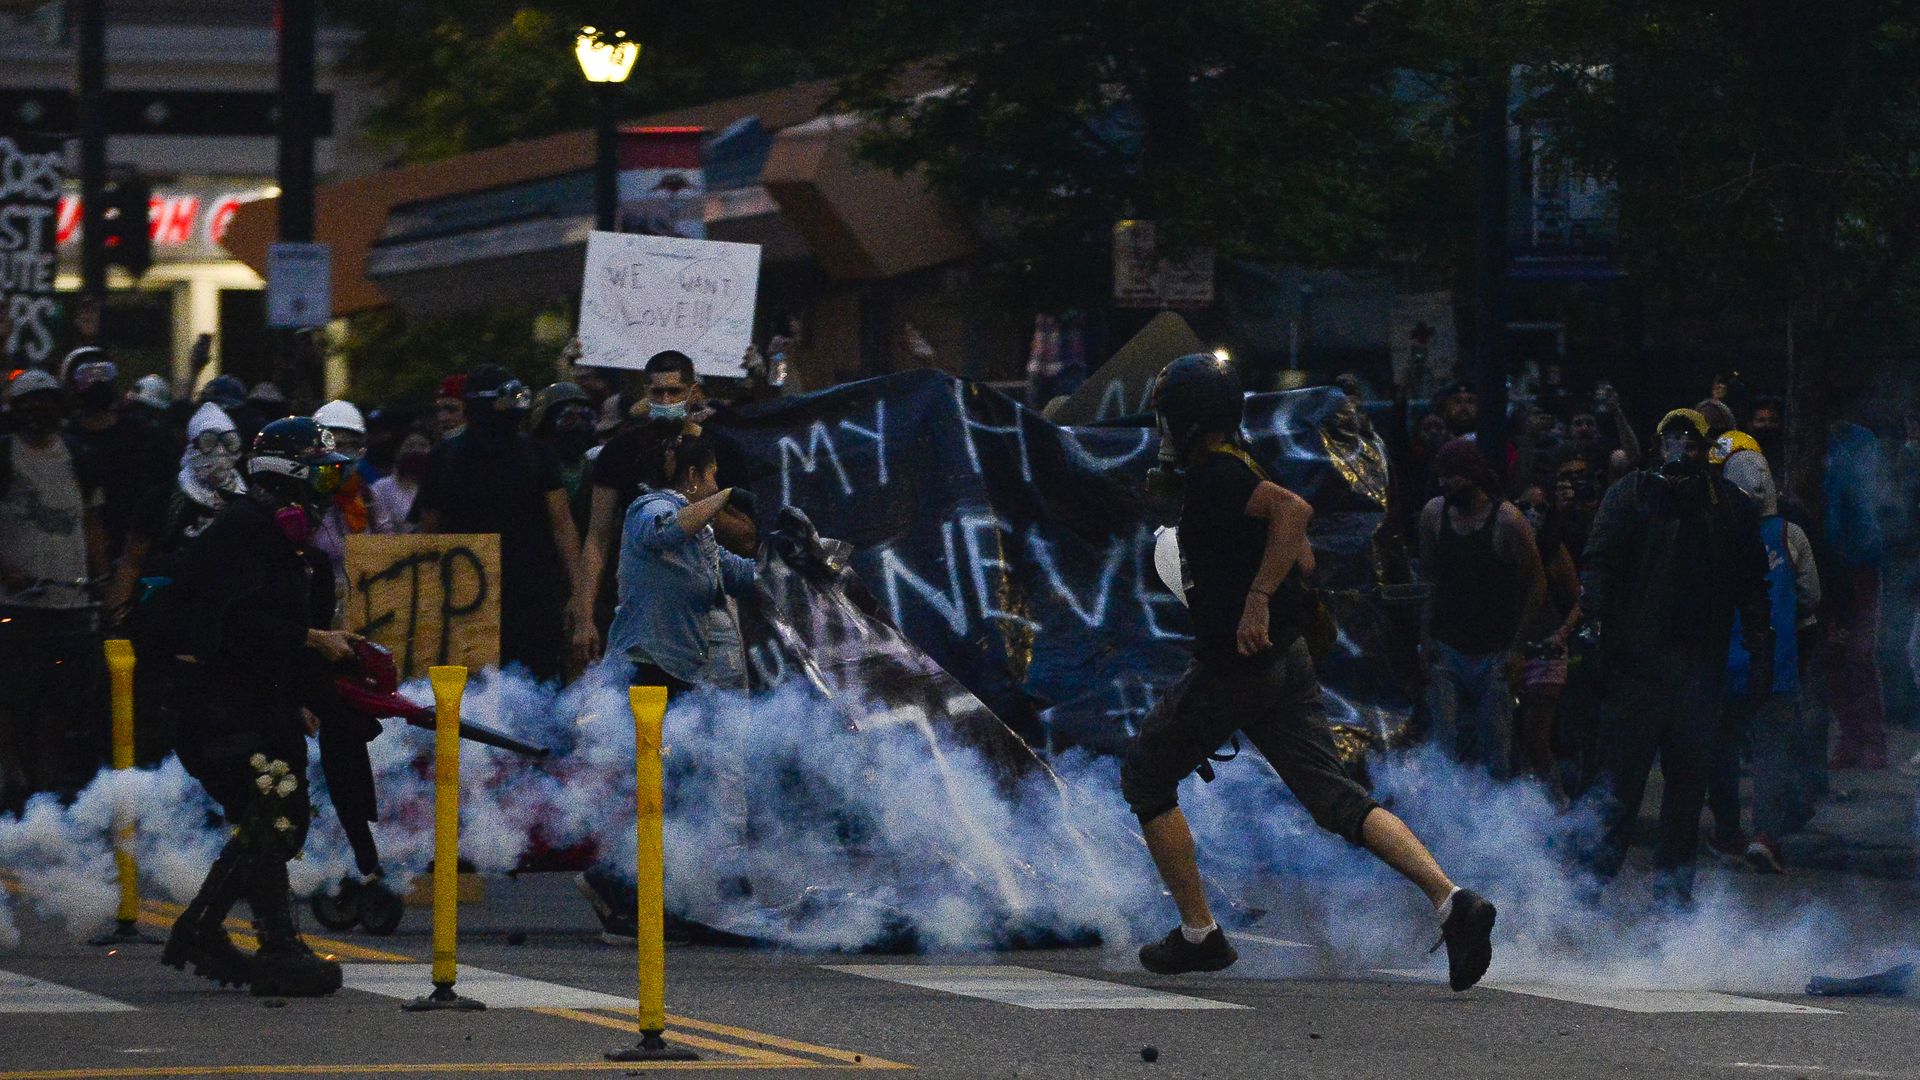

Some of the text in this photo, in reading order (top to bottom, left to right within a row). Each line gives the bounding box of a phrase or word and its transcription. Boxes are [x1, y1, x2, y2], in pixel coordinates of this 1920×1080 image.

[606, 262, 732, 296] WE WANT
[777, 399, 889, 507] MY
[879, 508, 1197, 641] NEVE
